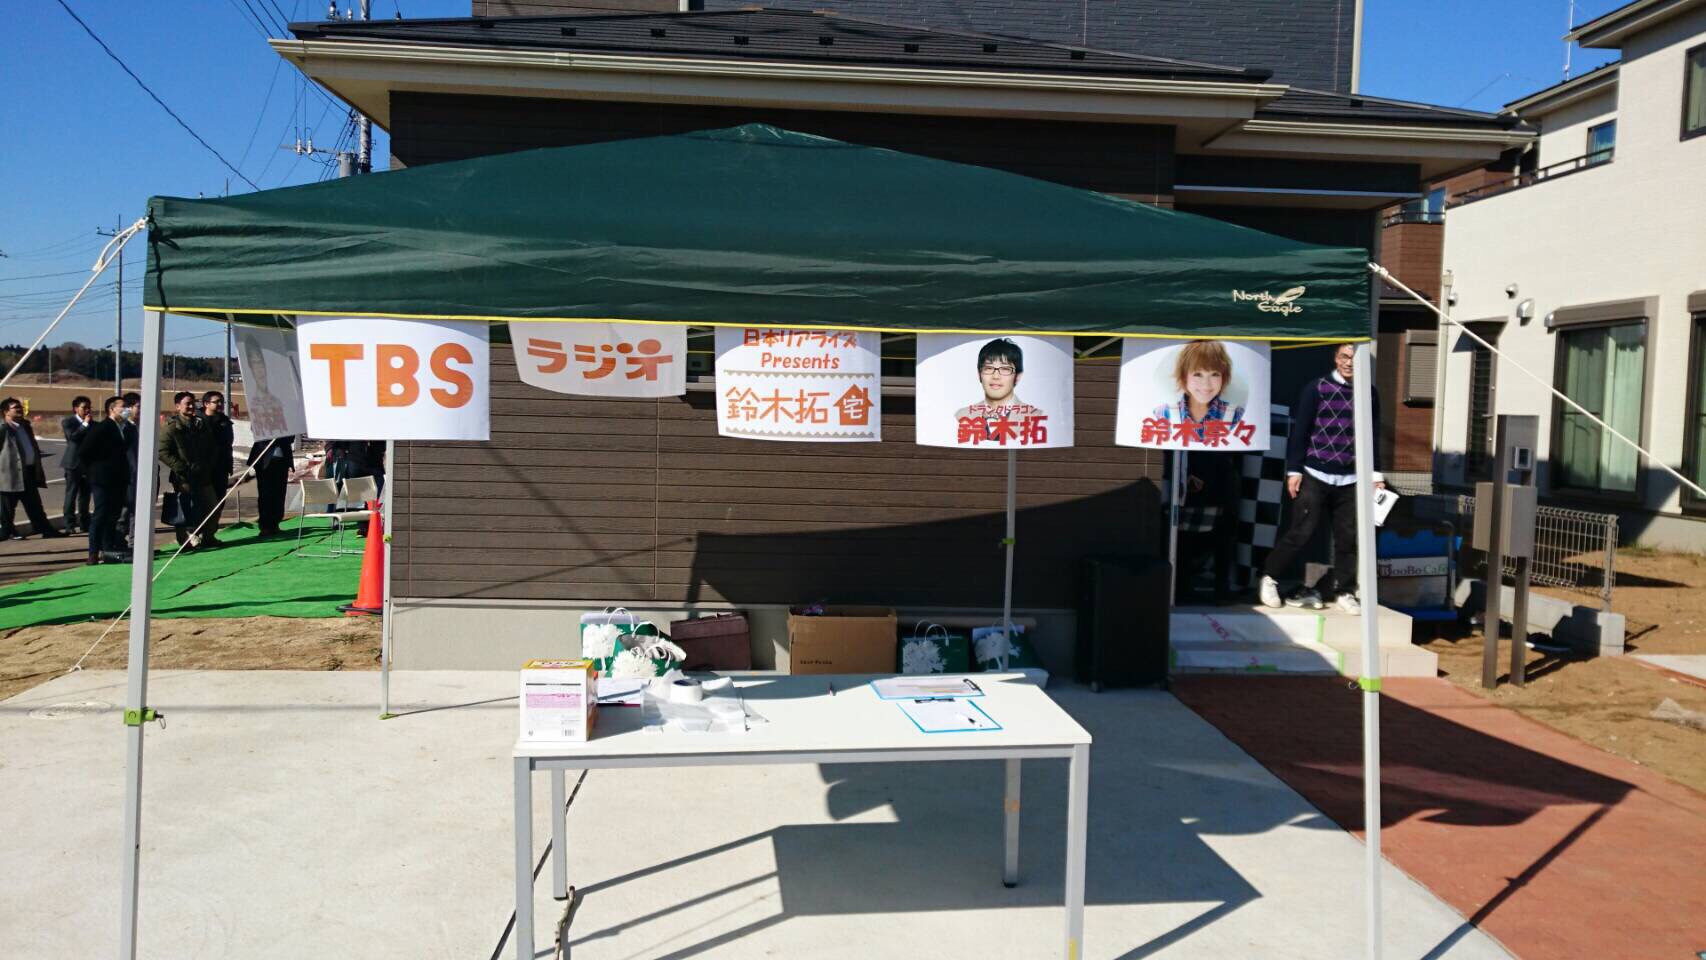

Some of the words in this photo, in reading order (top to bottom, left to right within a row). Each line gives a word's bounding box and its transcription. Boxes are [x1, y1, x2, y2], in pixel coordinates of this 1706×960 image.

[1232, 289, 1275, 302] North
[1257, 301, 1303, 316] Eagle
[743, 328, 857, 348] 日本リアライズ
[527, 338, 673, 381] ラジオ
[761, 352, 840, 369] Presents
[309, 342, 474, 409] TBS
[968, 404, 1038, 415] ドランクドラゴン
[957, 415, 1048, 446] 鈴木拓
[1140, 417, 1256, 447] 鈴木奈々
